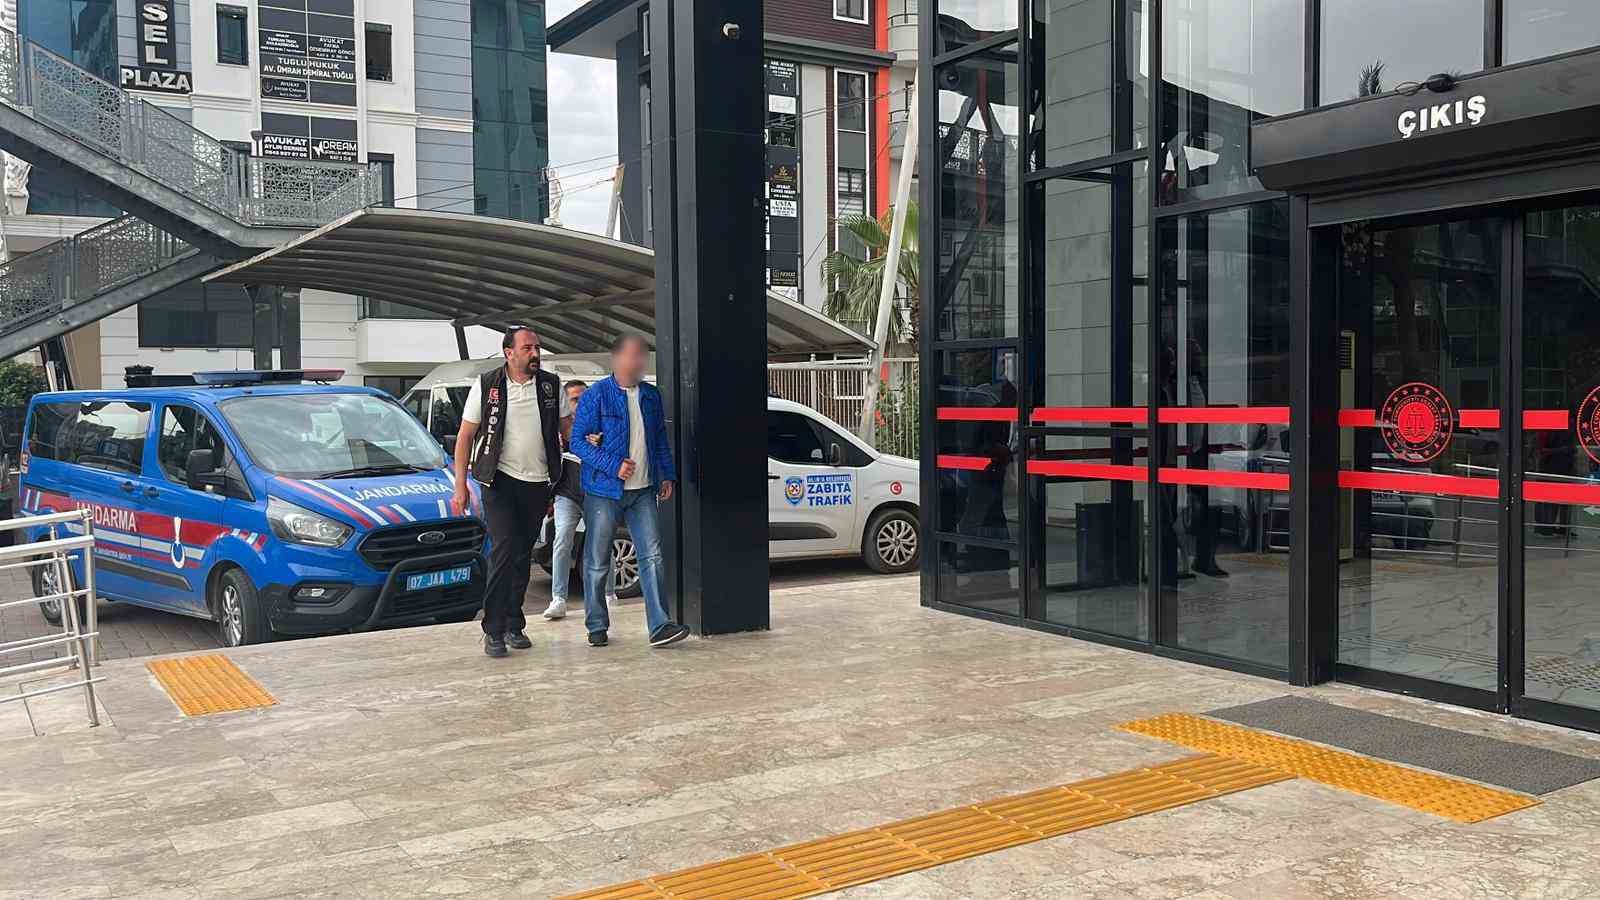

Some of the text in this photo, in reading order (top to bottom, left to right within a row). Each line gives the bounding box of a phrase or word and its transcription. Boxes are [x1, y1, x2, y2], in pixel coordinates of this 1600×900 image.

[319, 37, 344, 45] AVUKAT
[309, 60, 340, 70] HUKUK
[263, 65, 276, 73] AV.
[332, 71, 354, 80] TUĞLU
[120, 68, 191, 91] PLAZA
[1397, 95, 1486, 139] ÇIKIŞ
[263, 135, 308, 146] AVUKAT
[323, 140, 357, 151] DREAM
[354, 483, 455, 501] JANDARMA
[807, 482, 852, 494] ZABITA
[807, 494, 852, 506] TRAFİK
[410, 567, 468, 588] 07 JAA 479
